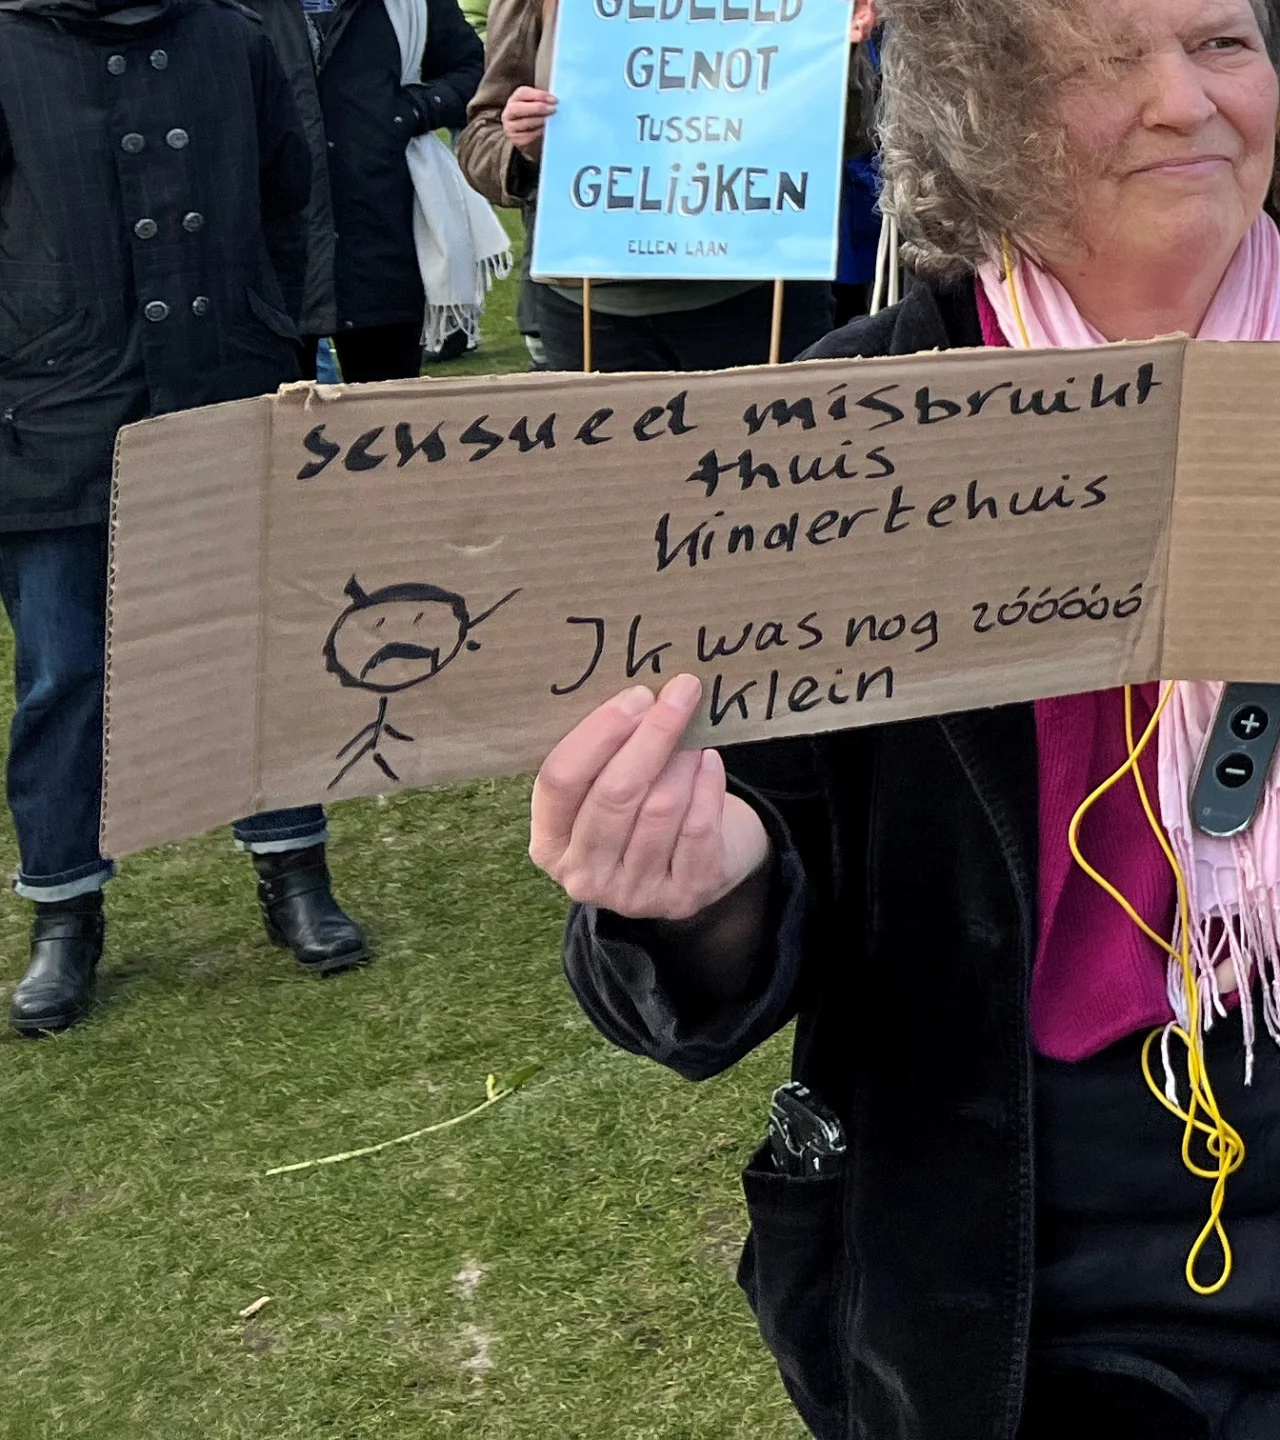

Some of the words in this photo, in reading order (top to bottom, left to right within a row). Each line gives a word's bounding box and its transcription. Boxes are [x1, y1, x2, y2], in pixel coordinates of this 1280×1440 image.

[623, 45, 779, 93] GENOT
[628, 239, 676, 255] ELLEN
[685, 240, 728, 256] LAAN
[686, 440, 895, 497] thuis
[697, 612, 823, 662] was
[846, 610, 938, 653] nog
